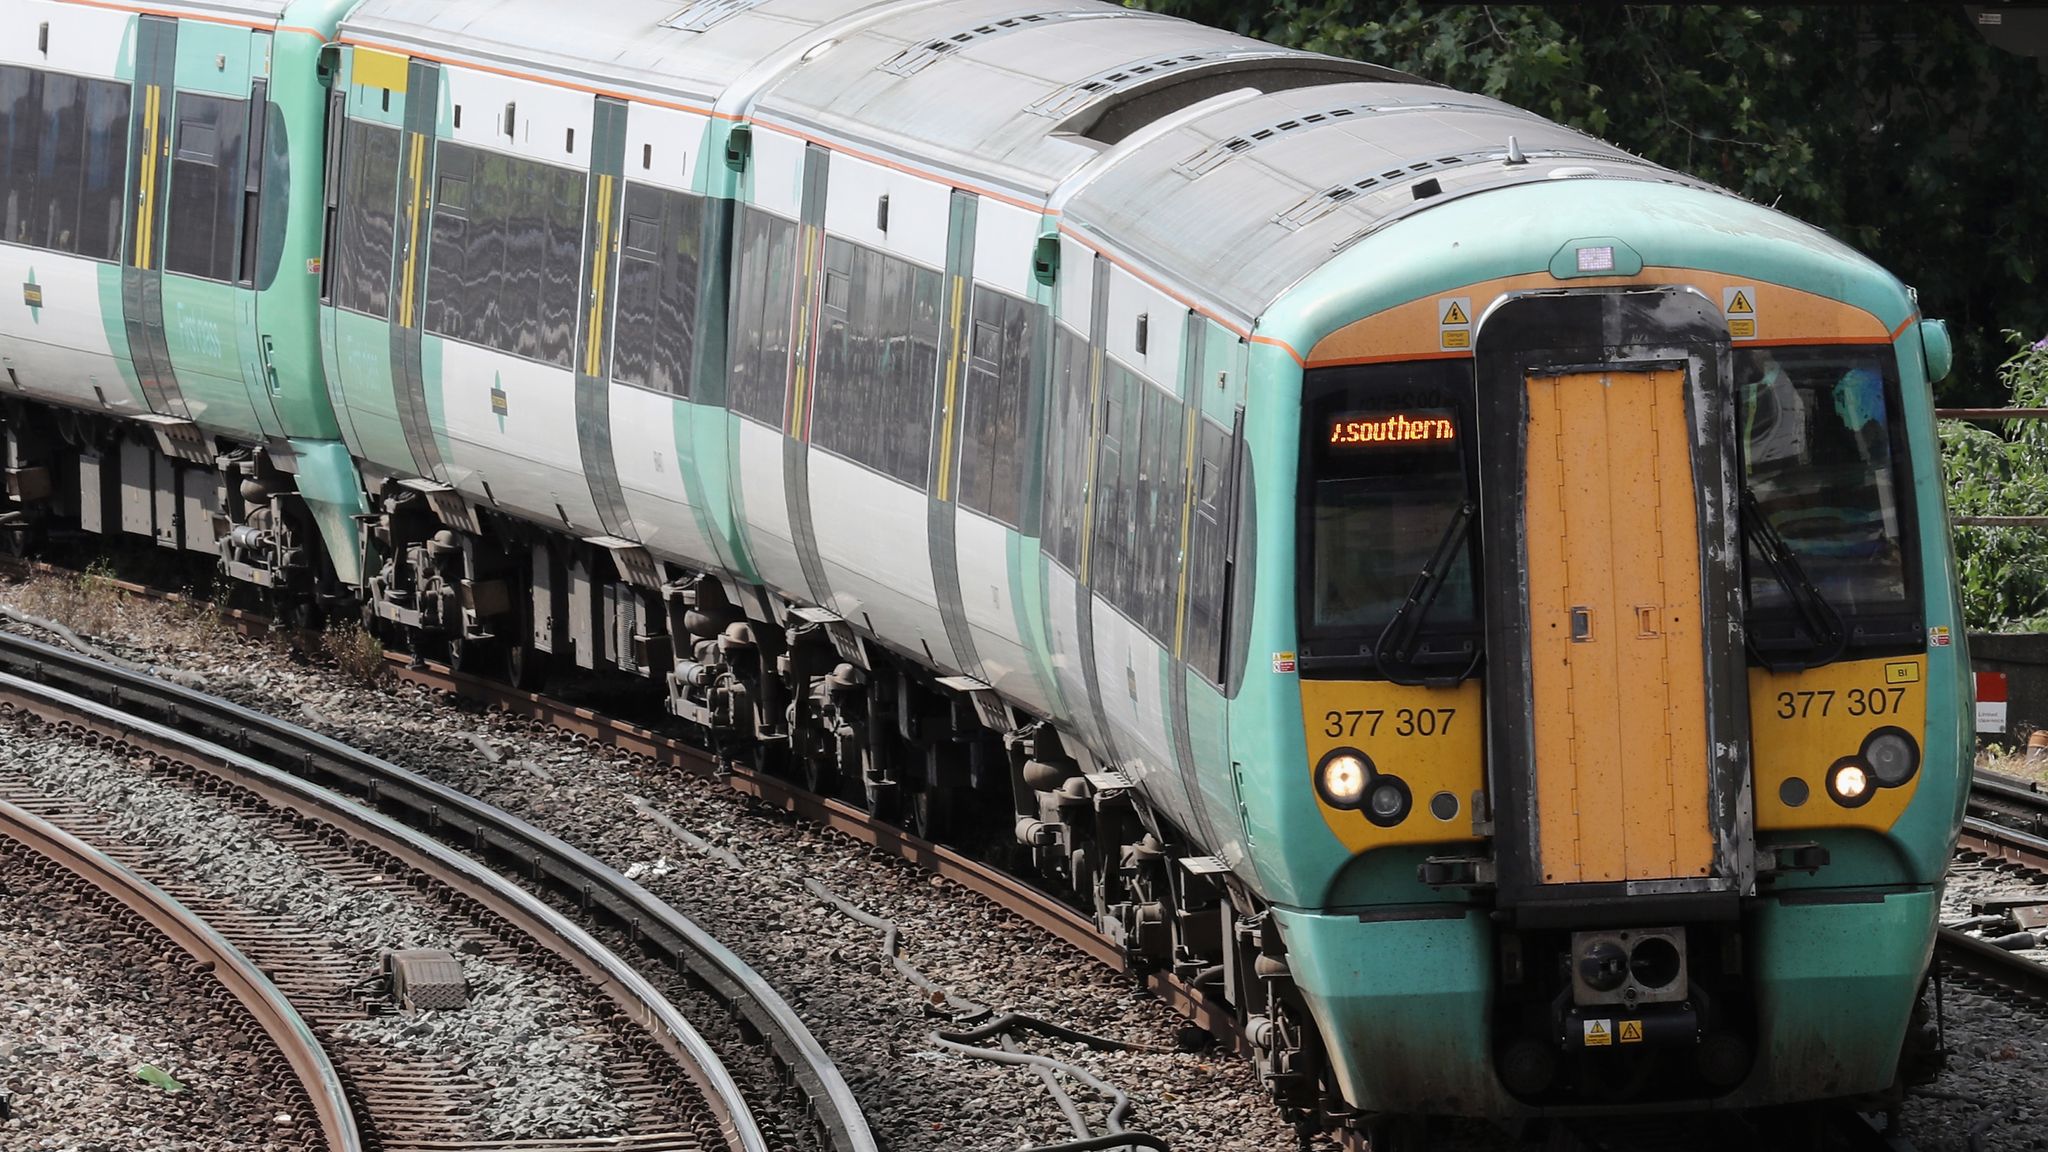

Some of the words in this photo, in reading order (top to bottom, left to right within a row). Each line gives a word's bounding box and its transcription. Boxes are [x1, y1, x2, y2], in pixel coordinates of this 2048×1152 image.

[1777, 690, 1836, 719] 377
[1848, 688, 1906, 716] 307
[1325, 710, 1385, 738] 377
[1396, 708, 1457, 737] 307
